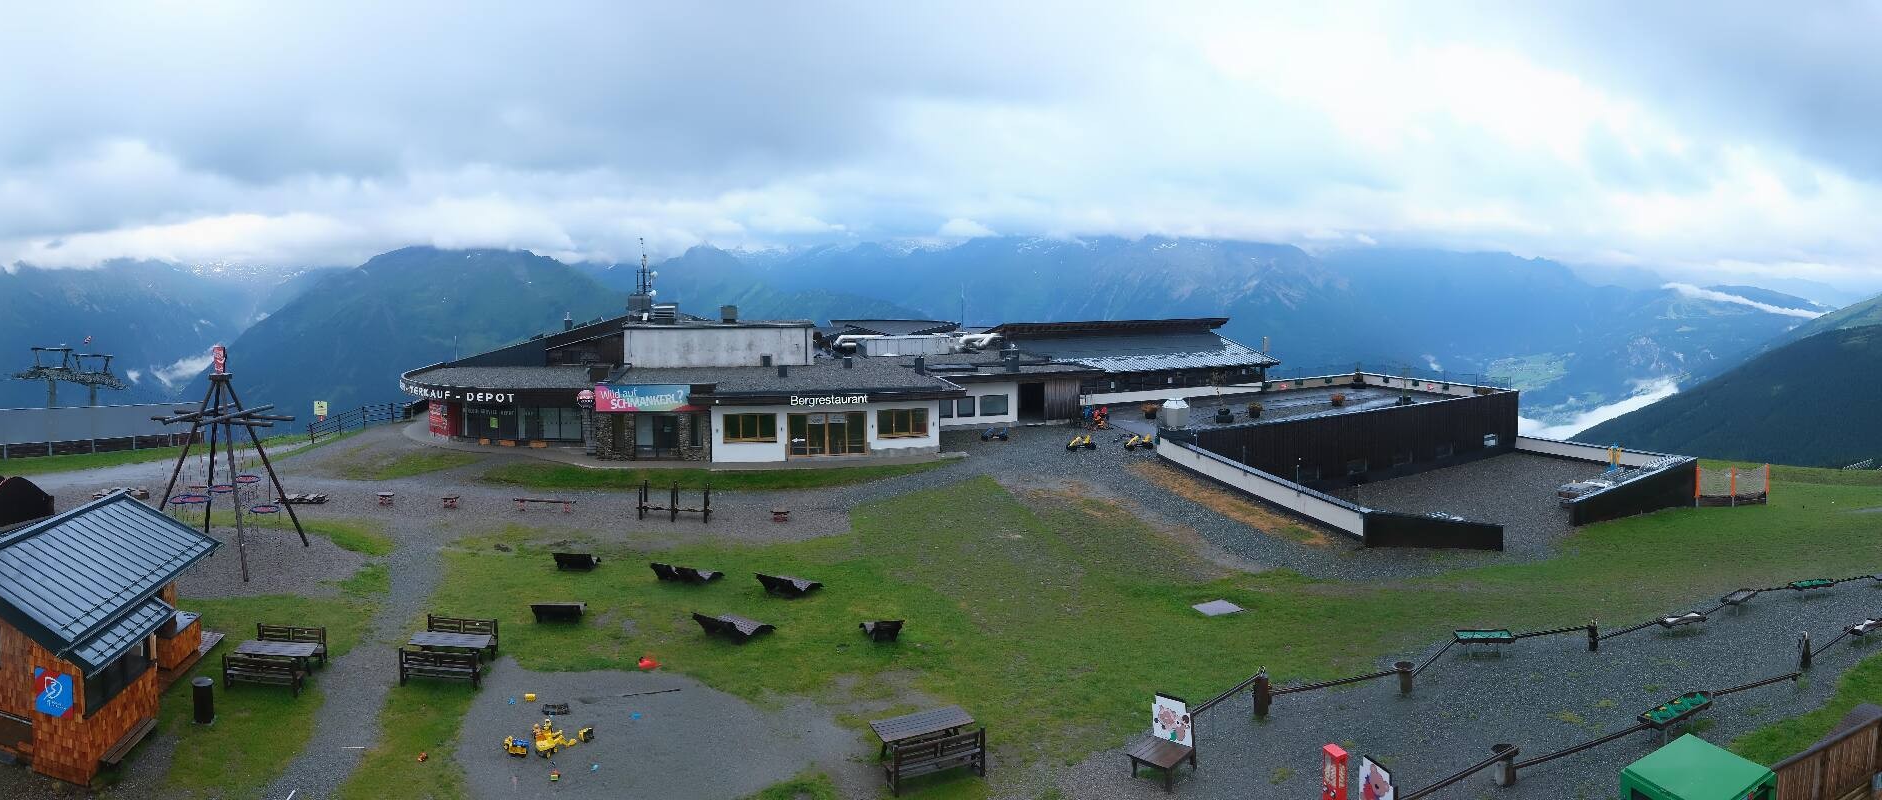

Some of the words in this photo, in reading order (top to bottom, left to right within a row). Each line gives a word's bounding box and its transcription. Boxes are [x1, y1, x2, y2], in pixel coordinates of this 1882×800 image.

[466, 392, 515, 403] DEPOT
[600, 388, 621, 400] Wild
[622, 388, 638, 399] auf
[610, 390, 684, 410] SCHMANKERL?
[790, 394, 869, 407] Bergrestaurant
